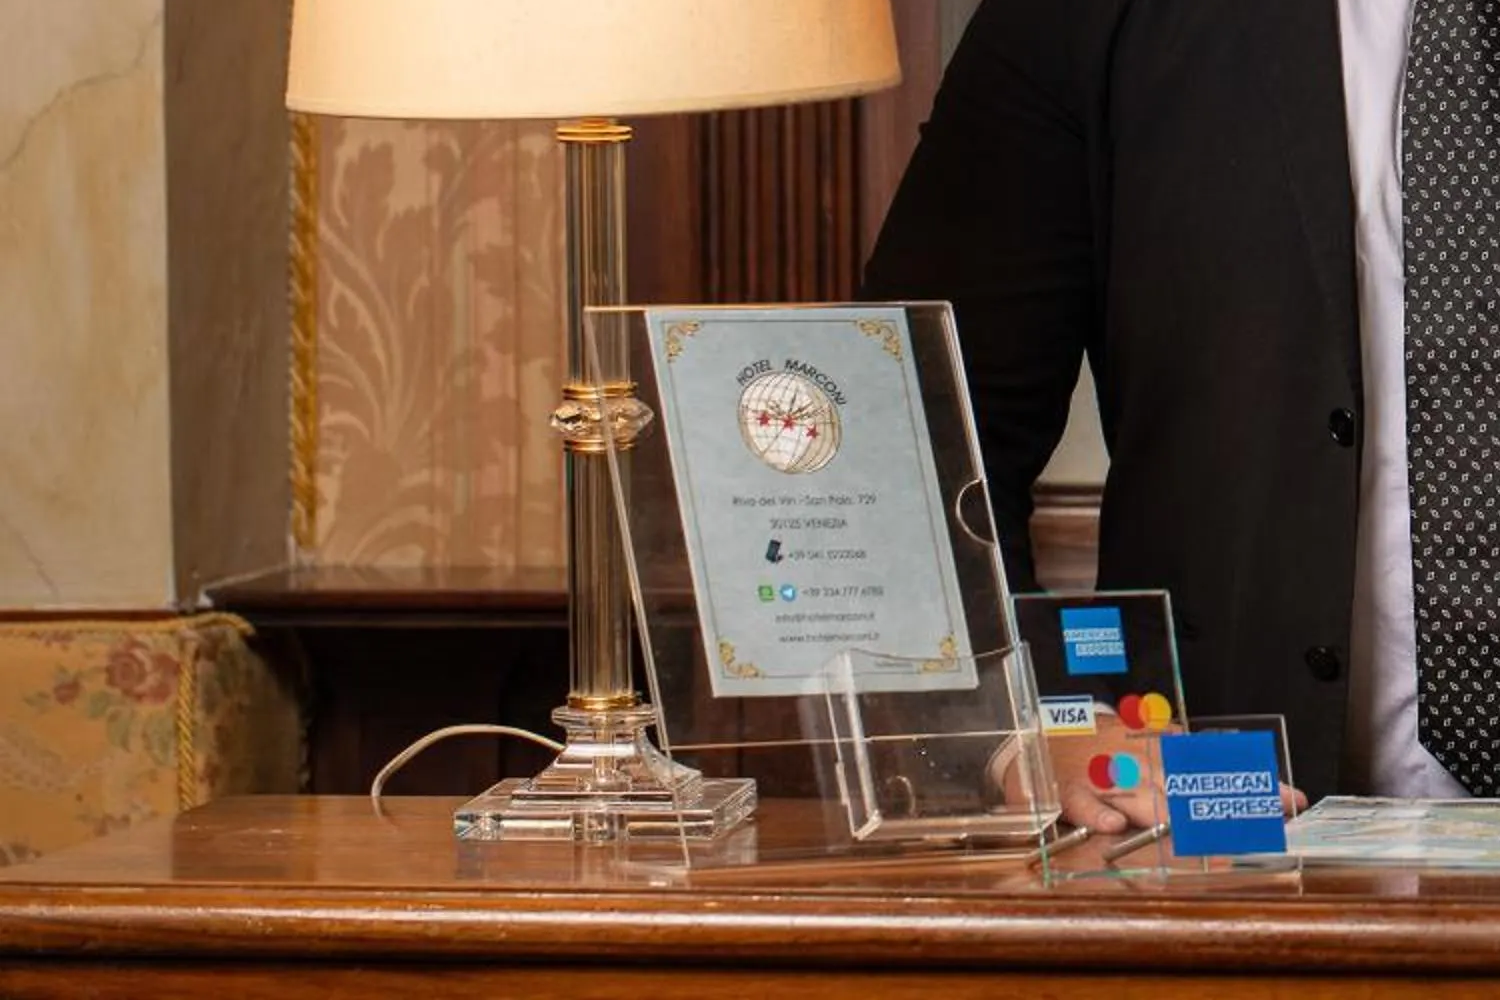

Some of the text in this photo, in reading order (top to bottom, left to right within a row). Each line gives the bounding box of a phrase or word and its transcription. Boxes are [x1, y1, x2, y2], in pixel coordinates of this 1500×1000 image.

[736, 359, 847, 405] HOTEL MARCONI
[803, 517, 848, 530] VENEZIA
[1063, 628, 1120, 641] AMERICAN
[1049, 706, 1089, 725] VISA
[1167, 773, 1271, 794] AMERICAN
[1191, 798, 1282, 819] EXPRESS
